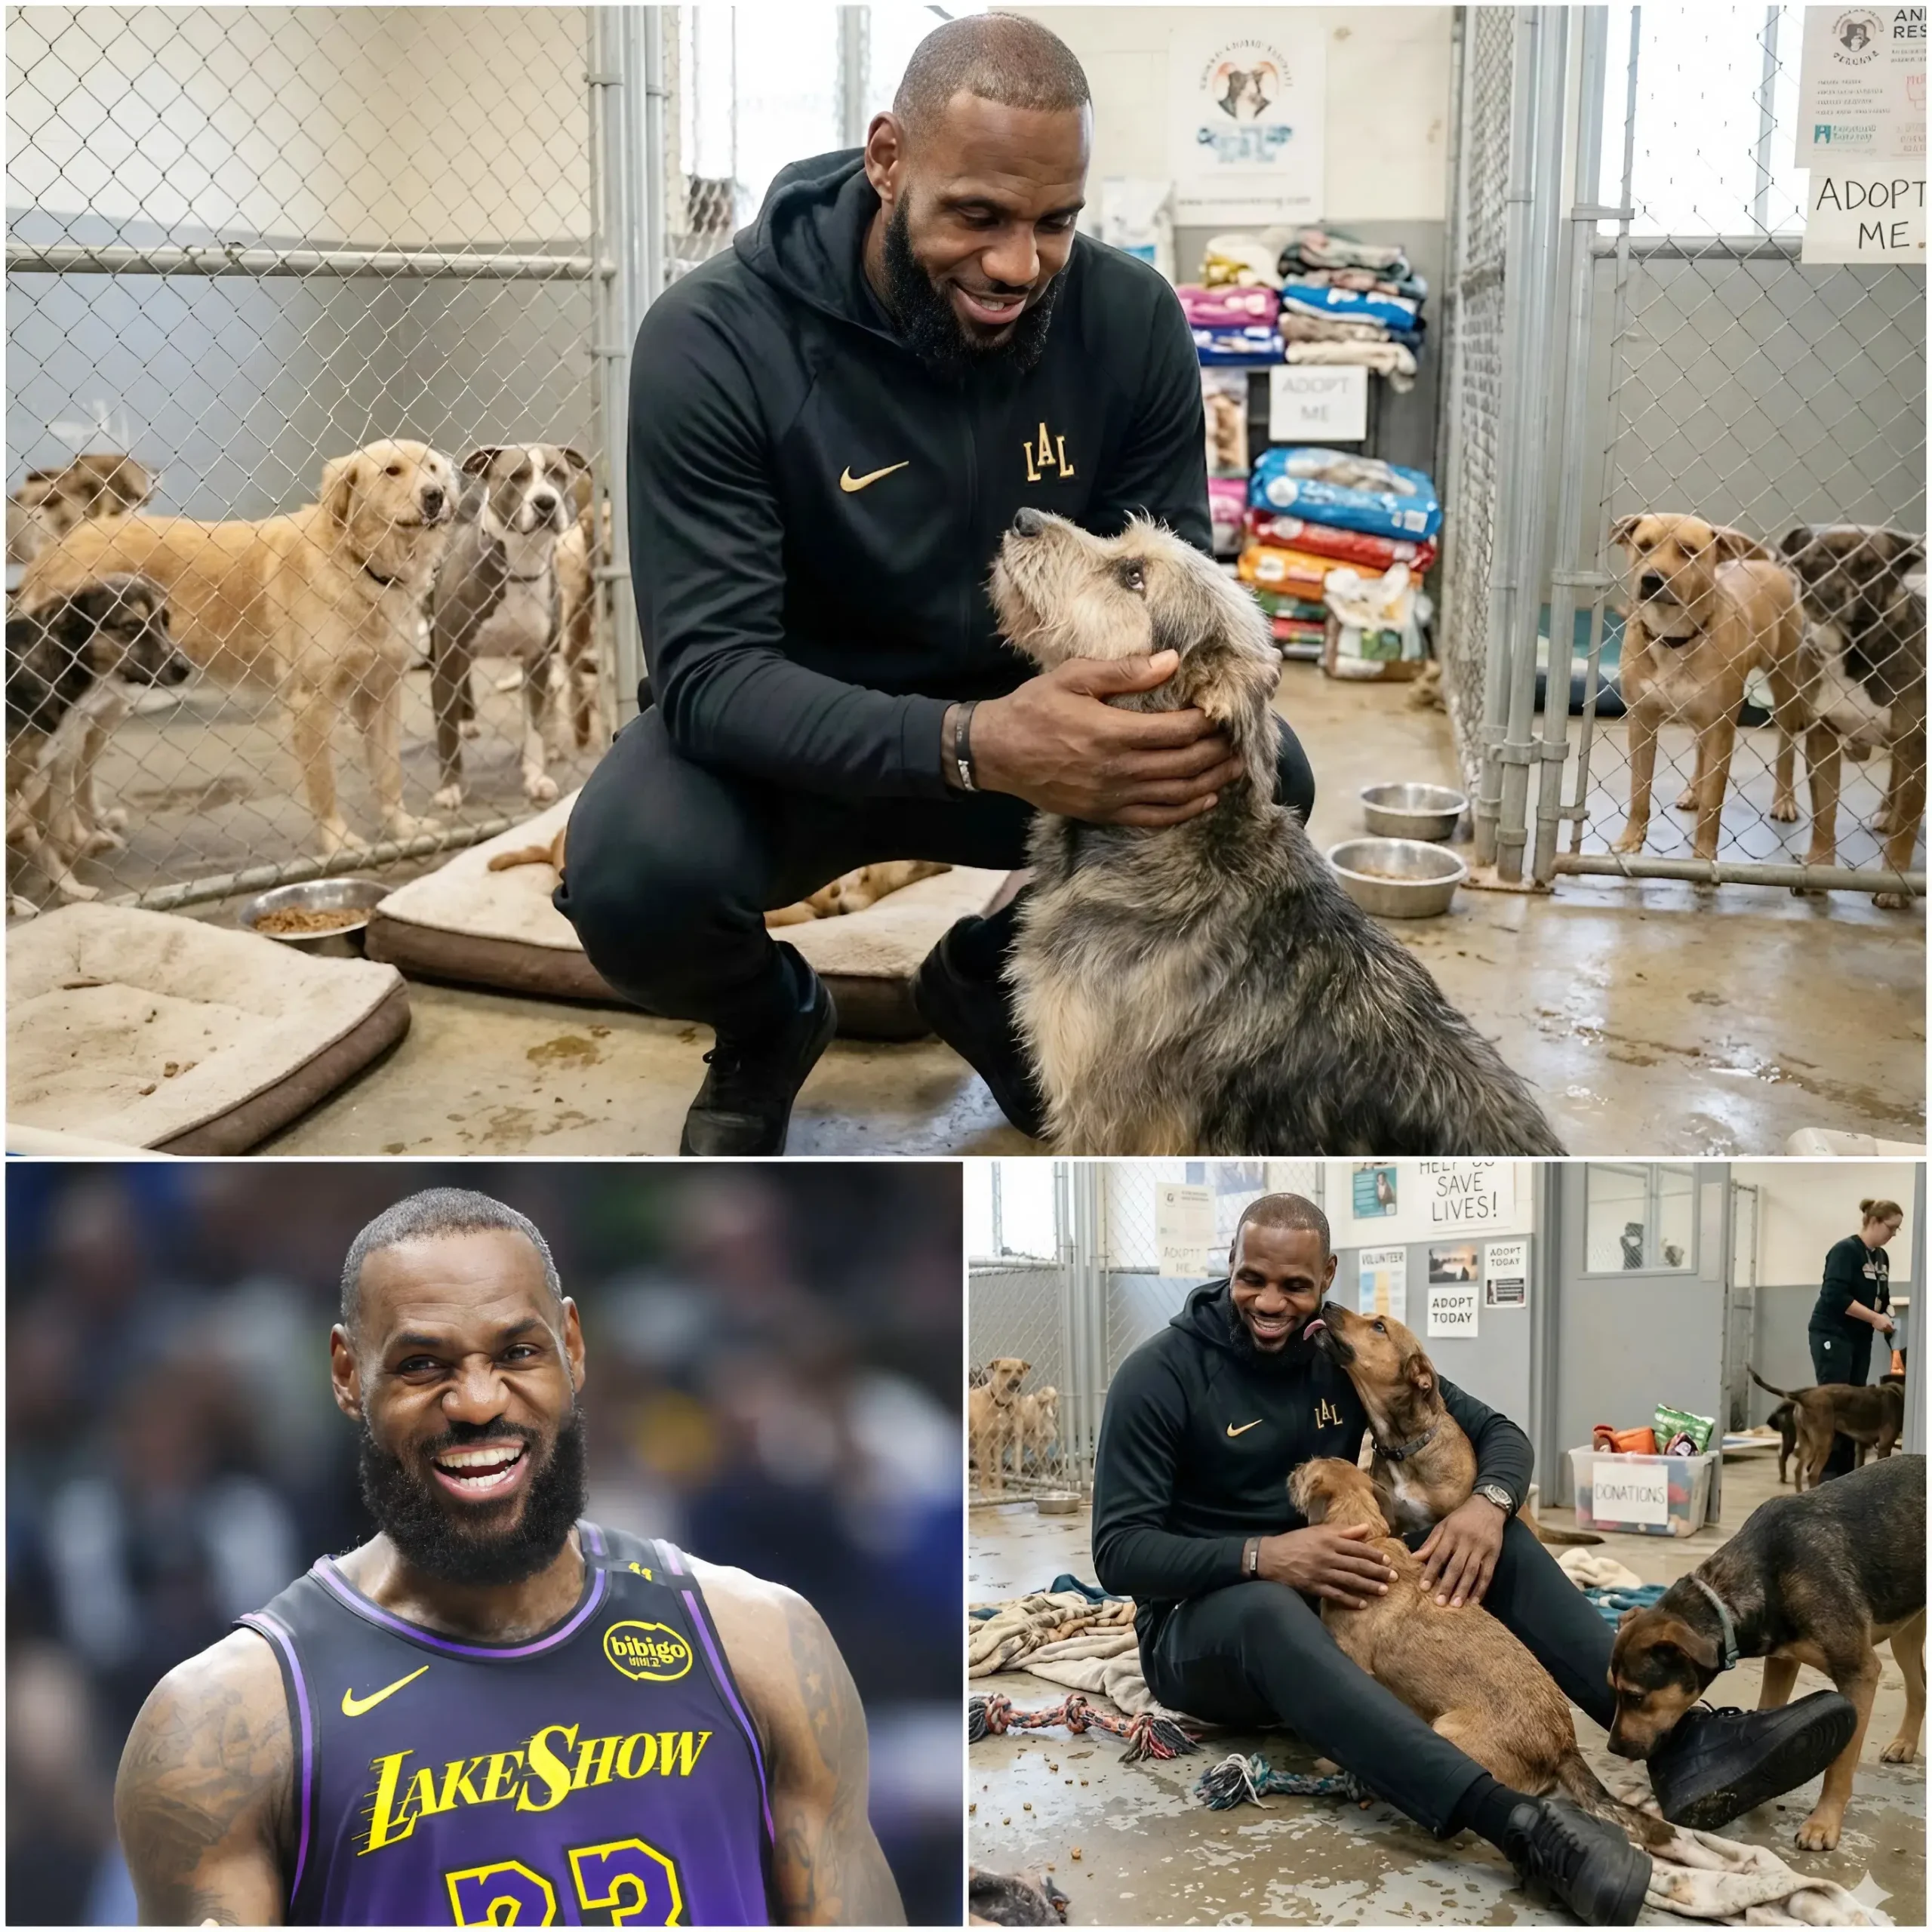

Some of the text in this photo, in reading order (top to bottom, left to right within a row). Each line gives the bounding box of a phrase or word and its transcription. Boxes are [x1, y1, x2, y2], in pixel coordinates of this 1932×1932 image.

[1817, 177, 1926, 211] ADOPT
[1023, 422, 1075, 481] LAL
[1436, 1171, 1483, 1197] SAVE
[1432, 1191, 1497, 1221] LIVES!
[1490, 1247, 1521, 1257] ADOPT
[1432, 1297, 1473, 1308] ADOPT
[1432, 1312, 1472, 1323] TODAY
[1314, 1398, 1343, 1429] LAL
[1595, 1482, 1666, 1504] DONATIONS
[610, 1635, 686, 1663] bibigo
[629, 1657, 661, 1667] 비비고
